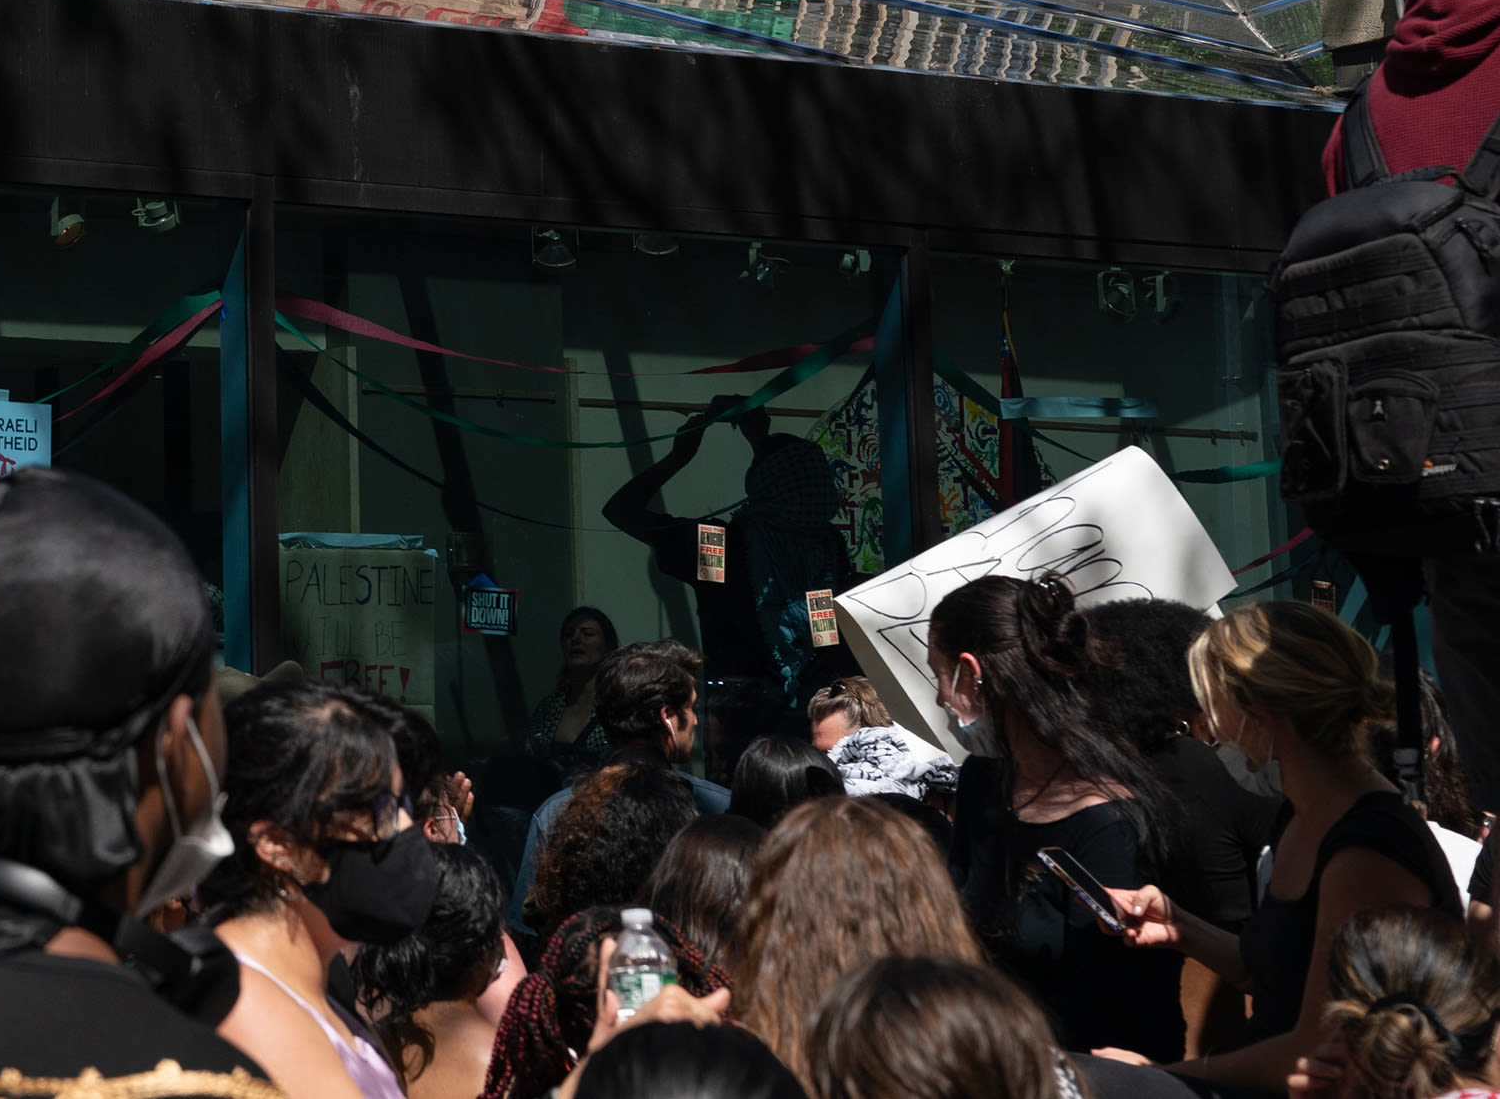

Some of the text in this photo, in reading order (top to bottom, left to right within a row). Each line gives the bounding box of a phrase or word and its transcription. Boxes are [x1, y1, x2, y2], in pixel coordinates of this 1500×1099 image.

[700, 546, 724, 555] FREE
[285, 560, 434, 606] PALESTINE
[471, 591, 509, 609] SHUT IT
[471, 607, 509, 625] DOWN!
[811, 610, 834, 619] FREE
[374, 620, 405, 657] BE
